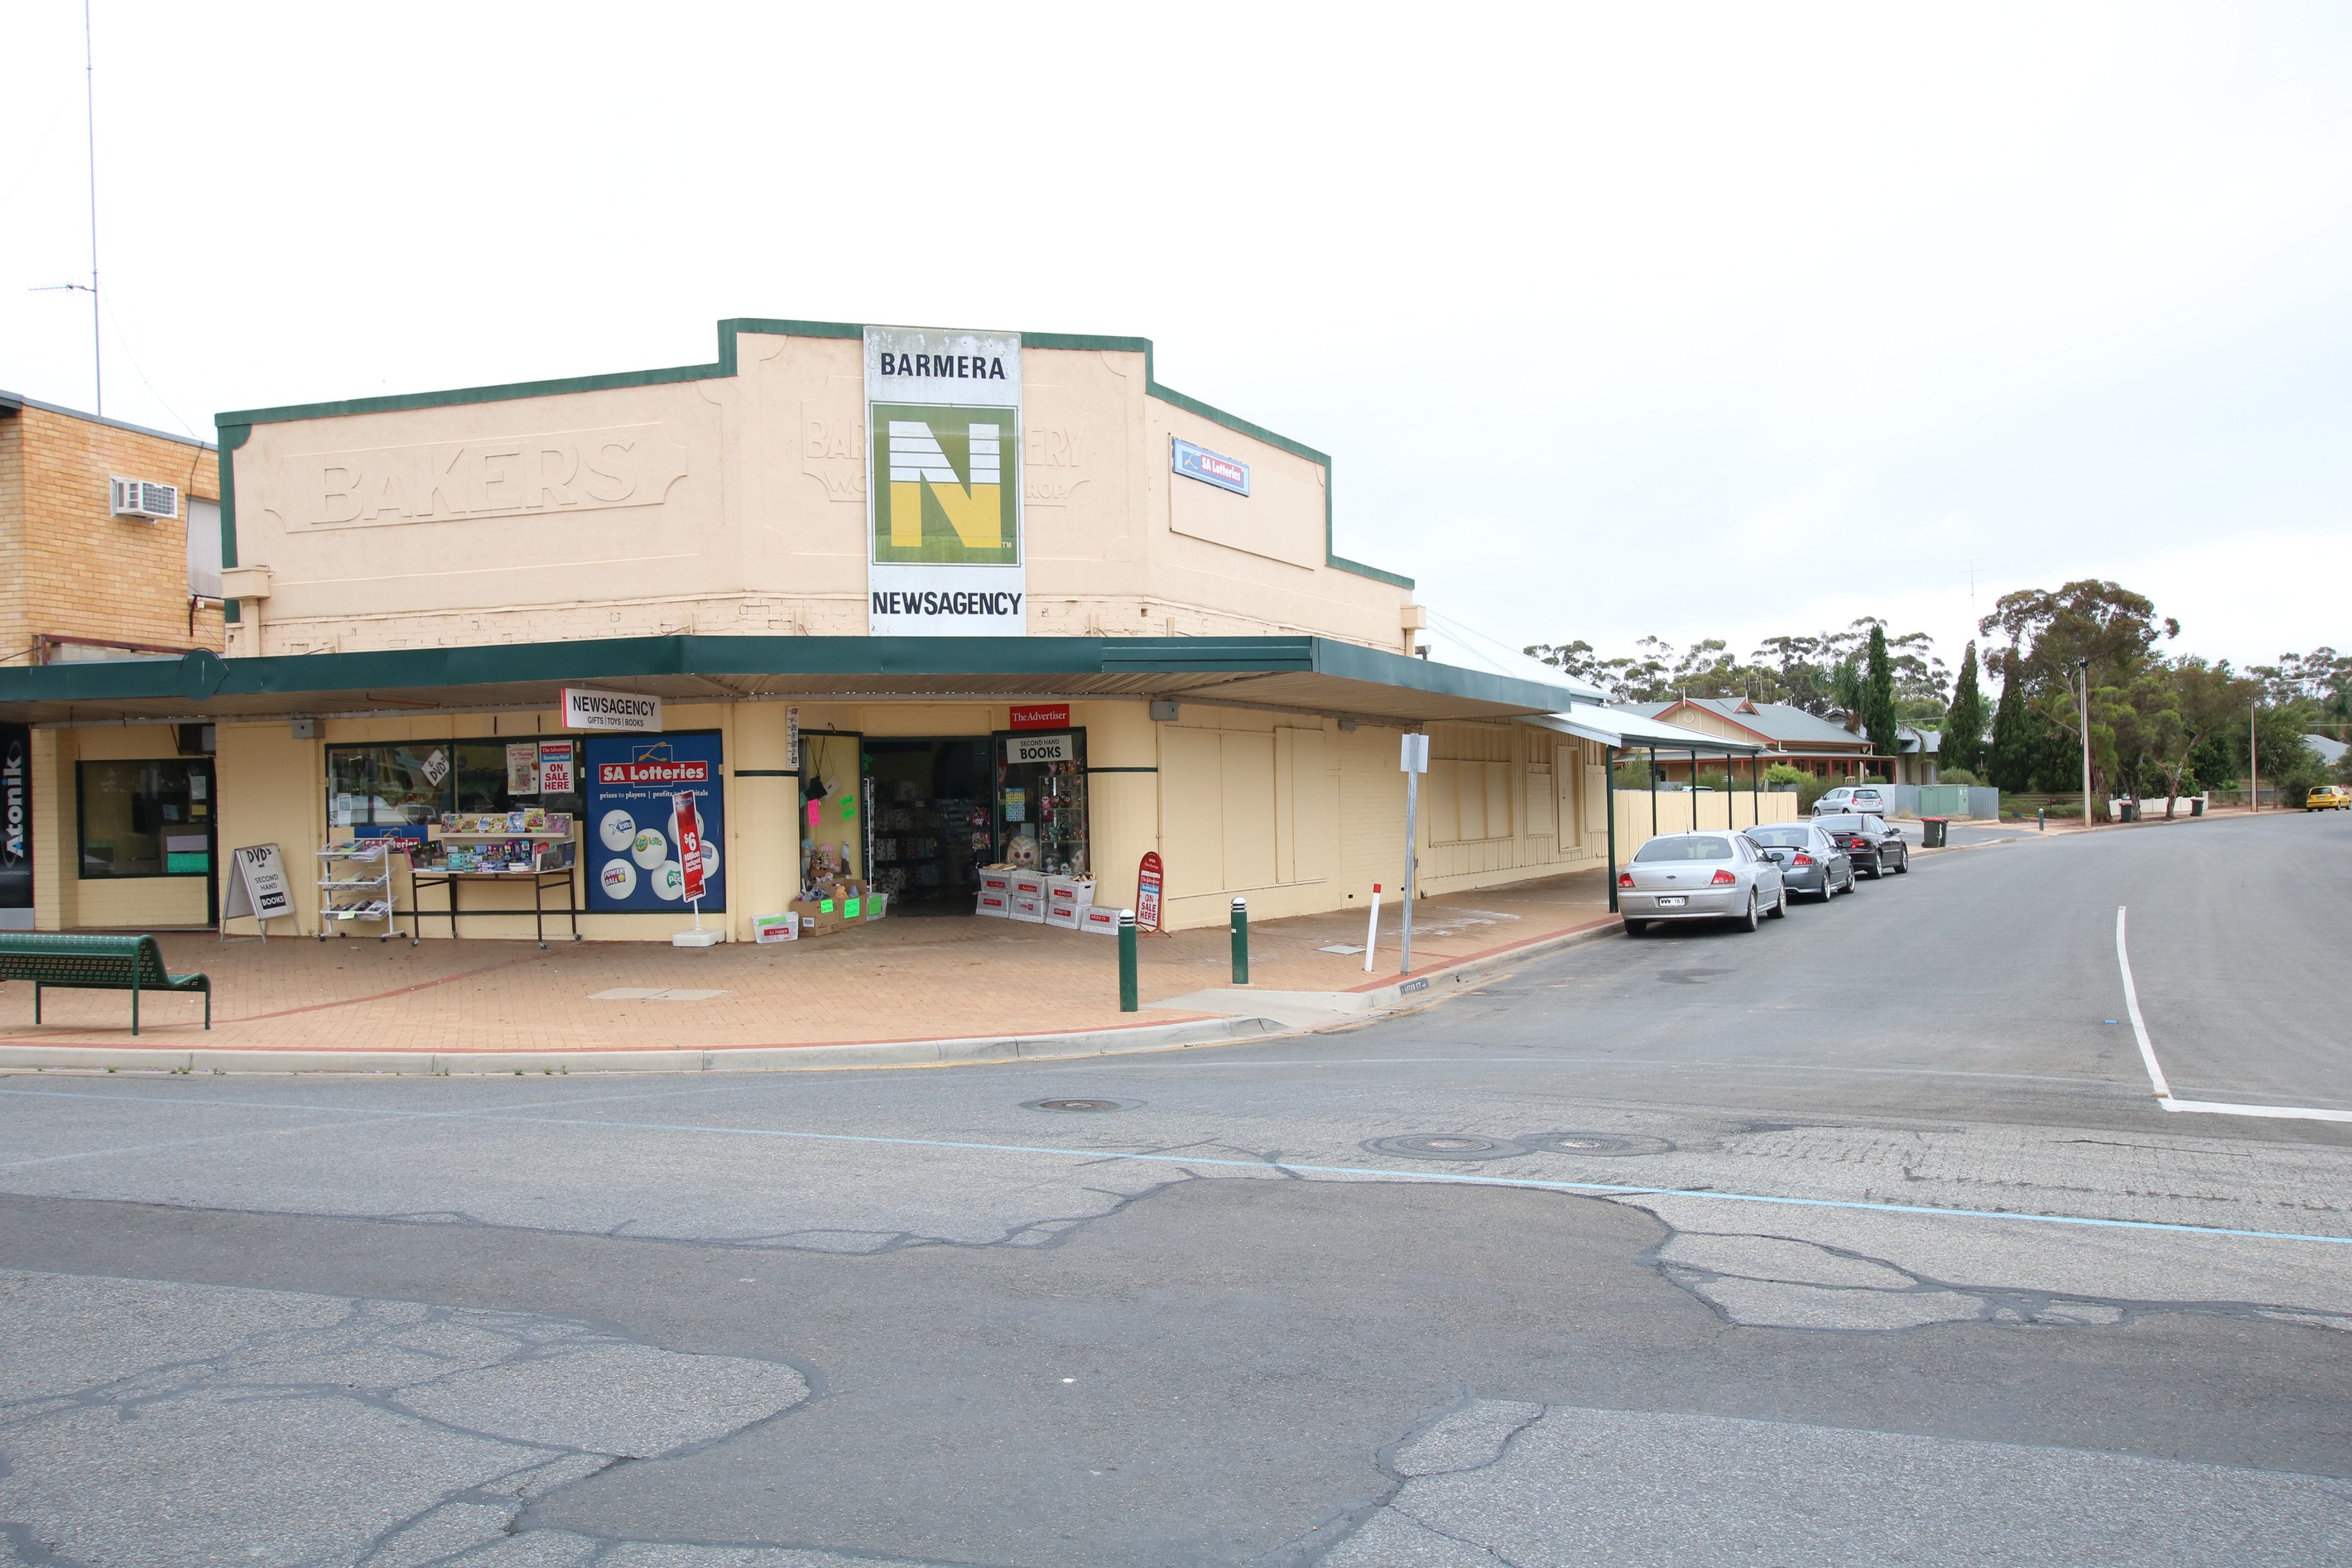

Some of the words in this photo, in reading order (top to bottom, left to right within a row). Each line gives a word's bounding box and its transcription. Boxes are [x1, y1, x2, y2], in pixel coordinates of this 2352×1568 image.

[881, 353, 1005, 380] BARMERA
[1201, 456, 1211, 472] SA
[1212, 459, 1241, 482] Lotteries
[310, 435, 638, 525] BAKERS
[889, 421, 1002, 548] N
[873, 591, 1022, 616] NEWSAGENCY
[573, 695, 656, 717] NEWSAGENCY
[587, 716, 604, 725] GIFTS
[607, 718, 622, 726] TOYS
[625, 719, 644, 727] BOOKS
[1012, 712, 1027, 722] The
[1027, 710, 1066, 721] Advertiser
[1020, 746, 1061, 759] BOOKS
[550, 763, 563, 772] ON
[604, 767, 625, 781] SA
[630, 763, 705, 780] Lotteries
[545, 772, 569, 781] SALE
[545, 782, 570, 790] HERE
[599, 791, 618, 800] prizes
[625, 791, 647, 800] players
[652, 790, 673, 800] profits
[2, 754, 23, 859] Atonik
[684, 831, 697, 851] $6
[684, 851, 700, 862] Million
[604, 867, 624, 878] POWER
[255, 874, 279, 883] SECOND
[261, 883, 278, 891] HAND
[261, 895, 285, 907] BOOKS
[1145, 894, 1153, 902] ON
[1141, 902, 1157, 912] SALE
[1140, 911, 1157, 921] HERE
